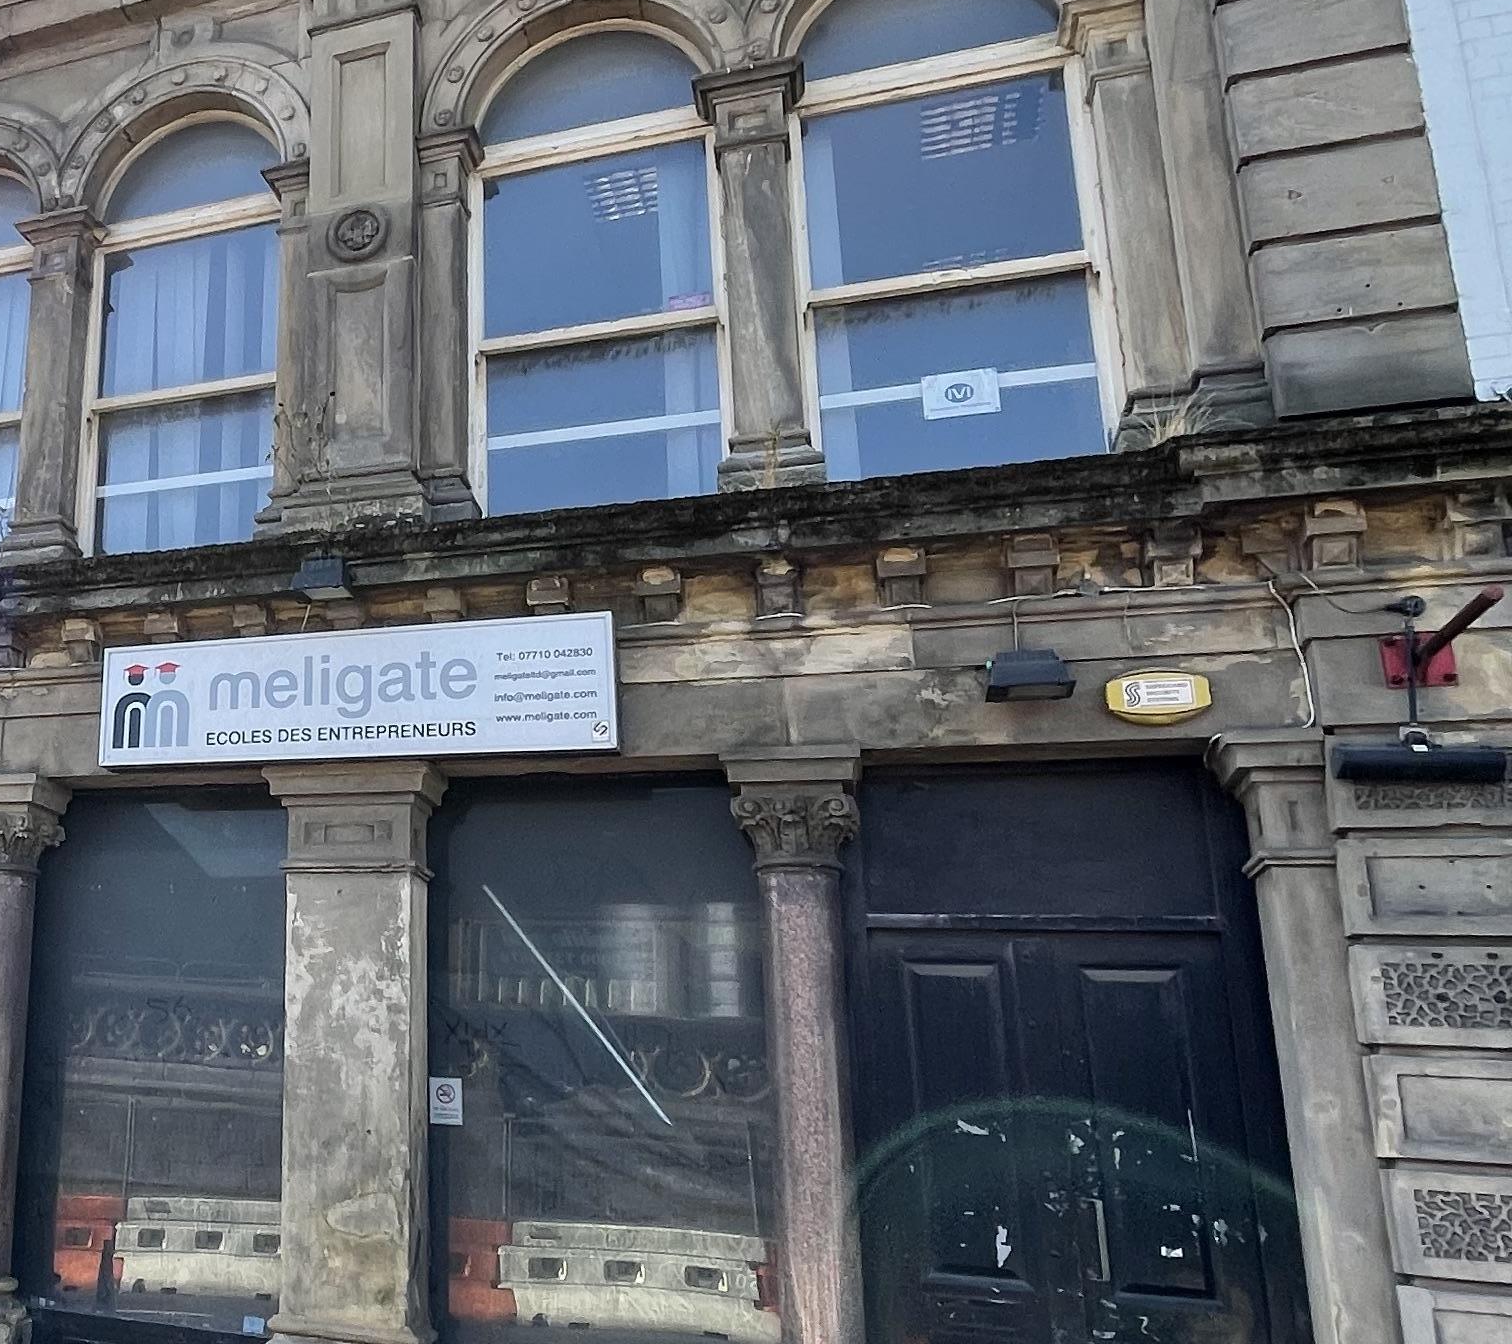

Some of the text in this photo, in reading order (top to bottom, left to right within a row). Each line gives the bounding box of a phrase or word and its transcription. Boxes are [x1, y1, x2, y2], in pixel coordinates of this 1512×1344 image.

[496, 647, 593, 662] Tel: 07710 042830
[209, 651, 477, 719] meligate
[494, 690, 598, 703] info@meligate.com
[495, 711, 597, 723] www.meligate.com
[206, 721, 477, 746] ECOLES DES ENTREPRENEURS
